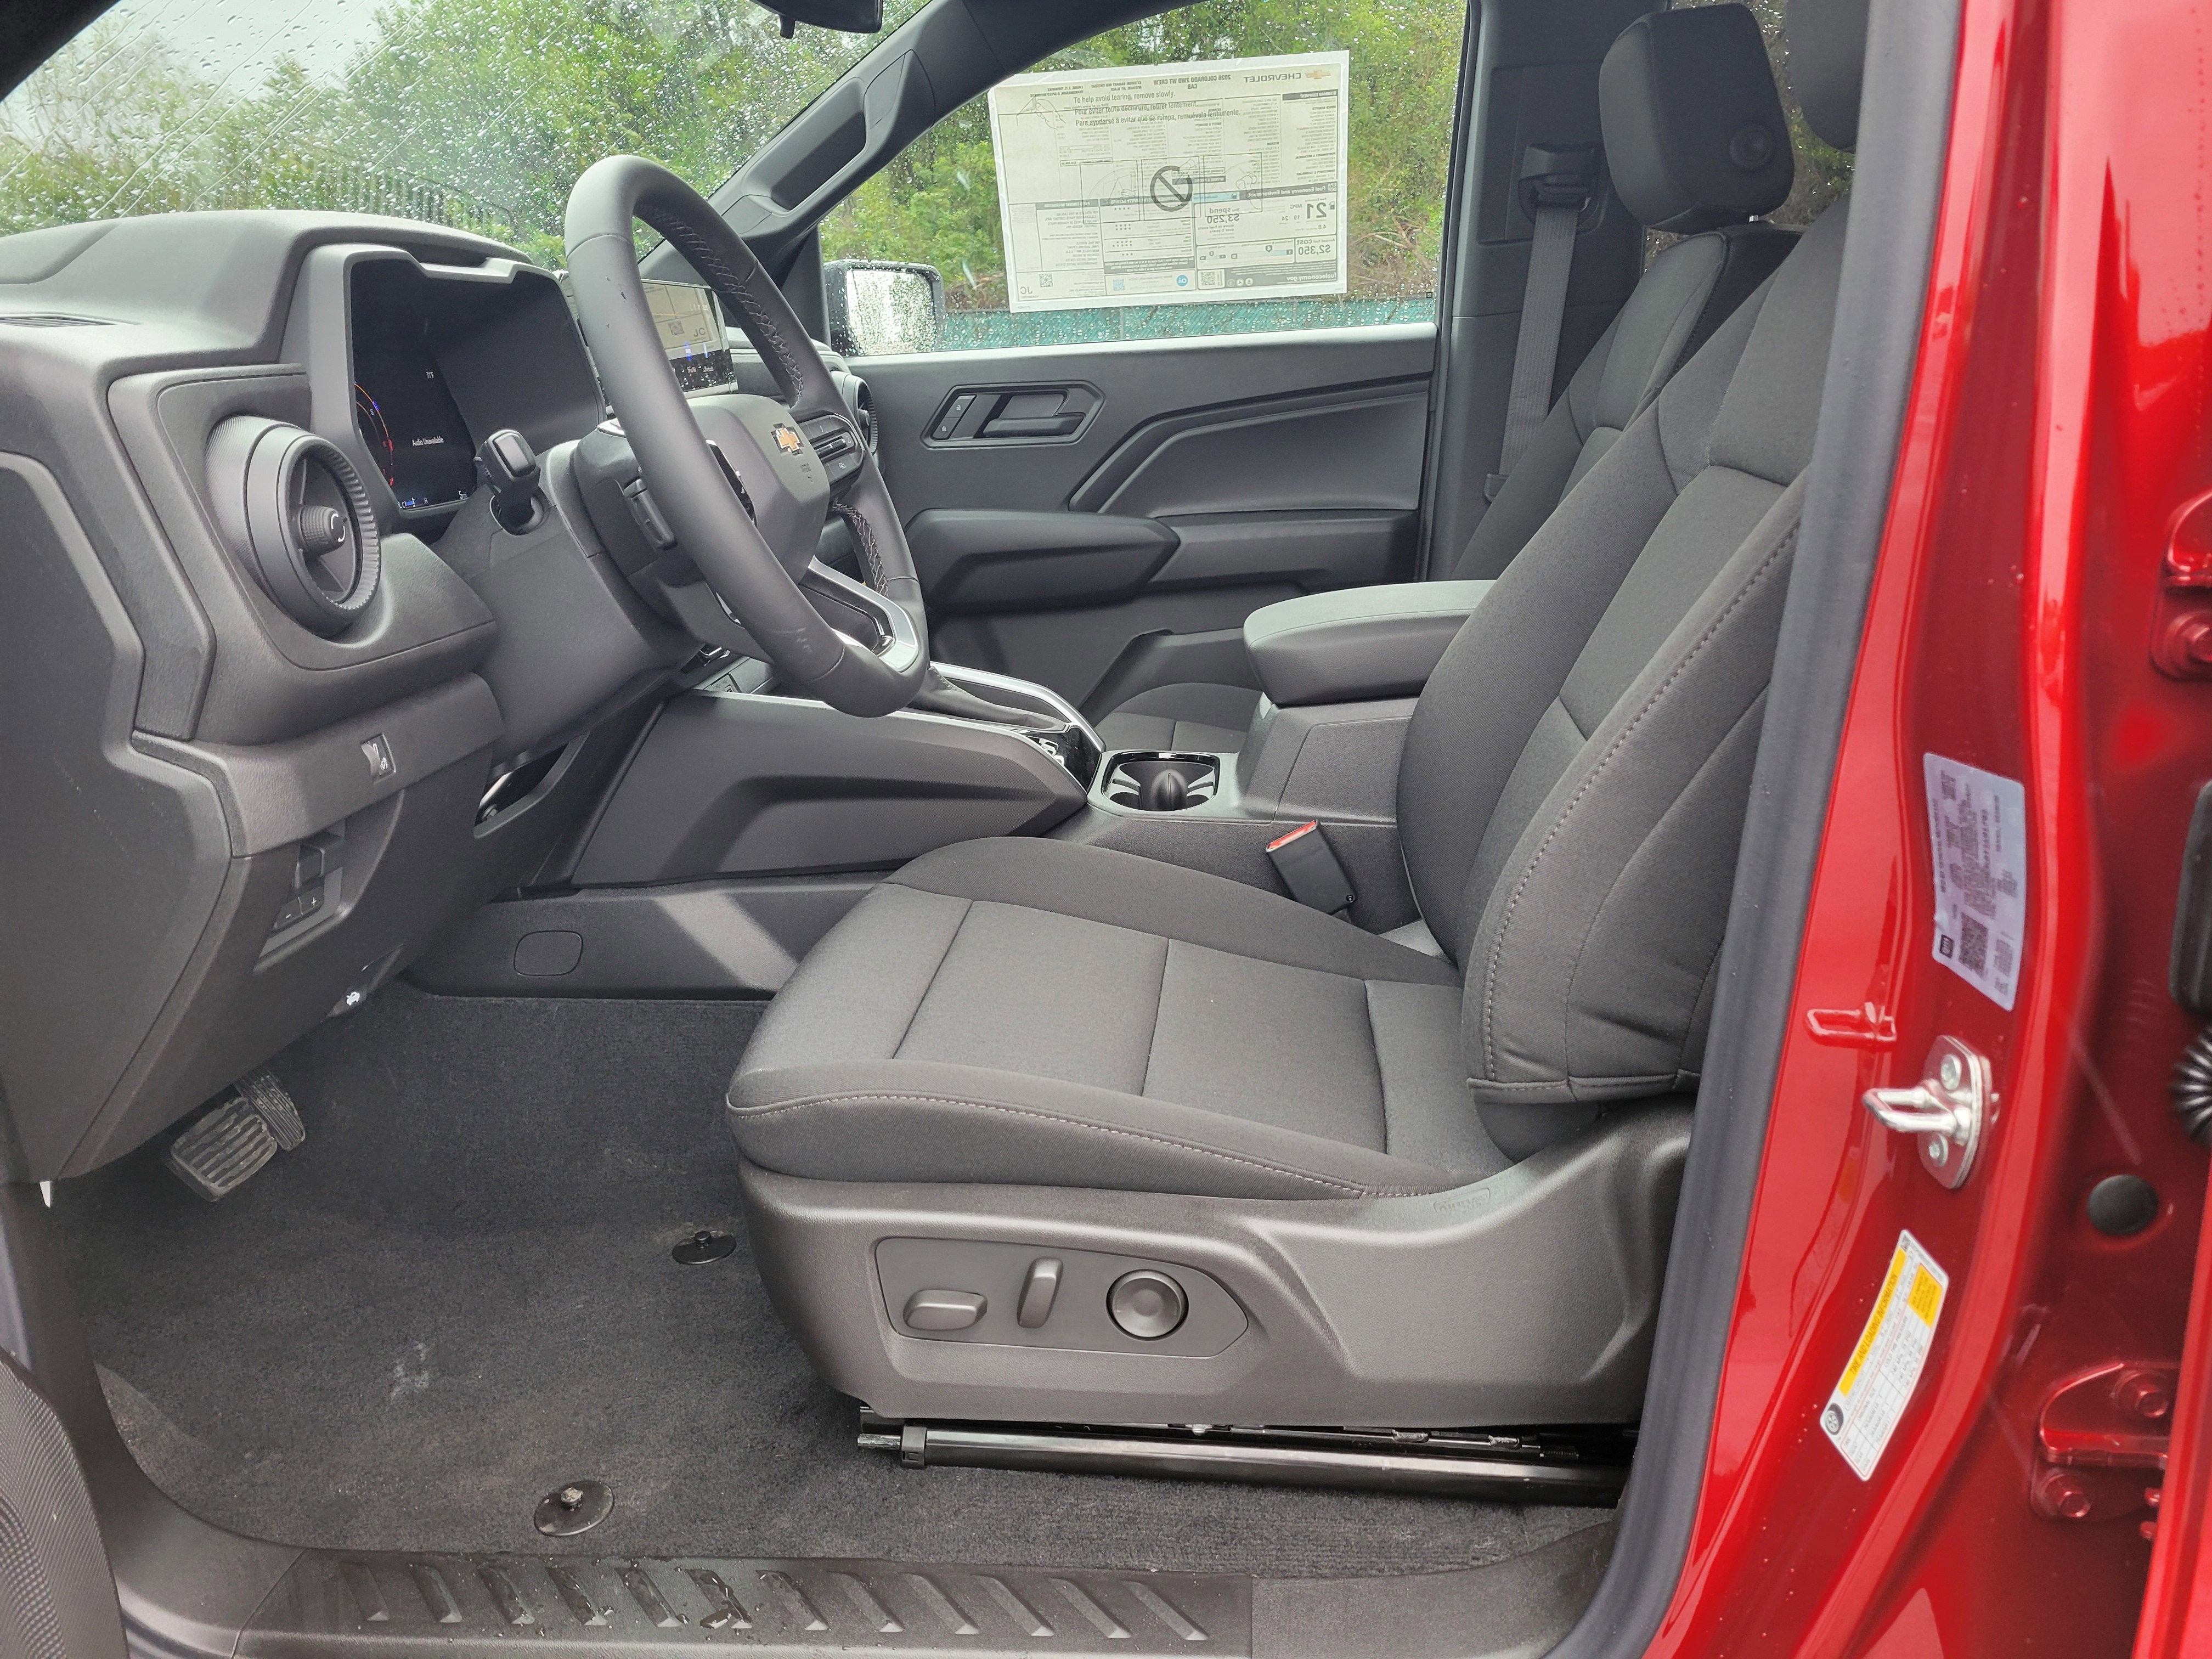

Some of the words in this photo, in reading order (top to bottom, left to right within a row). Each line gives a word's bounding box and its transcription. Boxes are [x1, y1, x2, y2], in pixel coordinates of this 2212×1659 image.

[1096, 94, 1110, 103] avoid
[1111, 93, 1133, 101] tearing,
[1156, 90, 1176, 99] slowly.
[1169, 101, 1198, 109] lentement.
[1090, 117, 1114, 127] ayudarse
[1177, 111, 1206, 120] remuévala
[1207, 109, 1241, 117] lentamente.
[693, 328, 706, 337] JC
[424, 436, 444, 445] Unavailable
[1850, 1360, 1861, 1374] TIRE
[1858, 1344, 1866, 1359] AND
[1863, 1317, 1880, 1346] LOADING
[1877, 1273, 1898, 1317] INFORMATION
